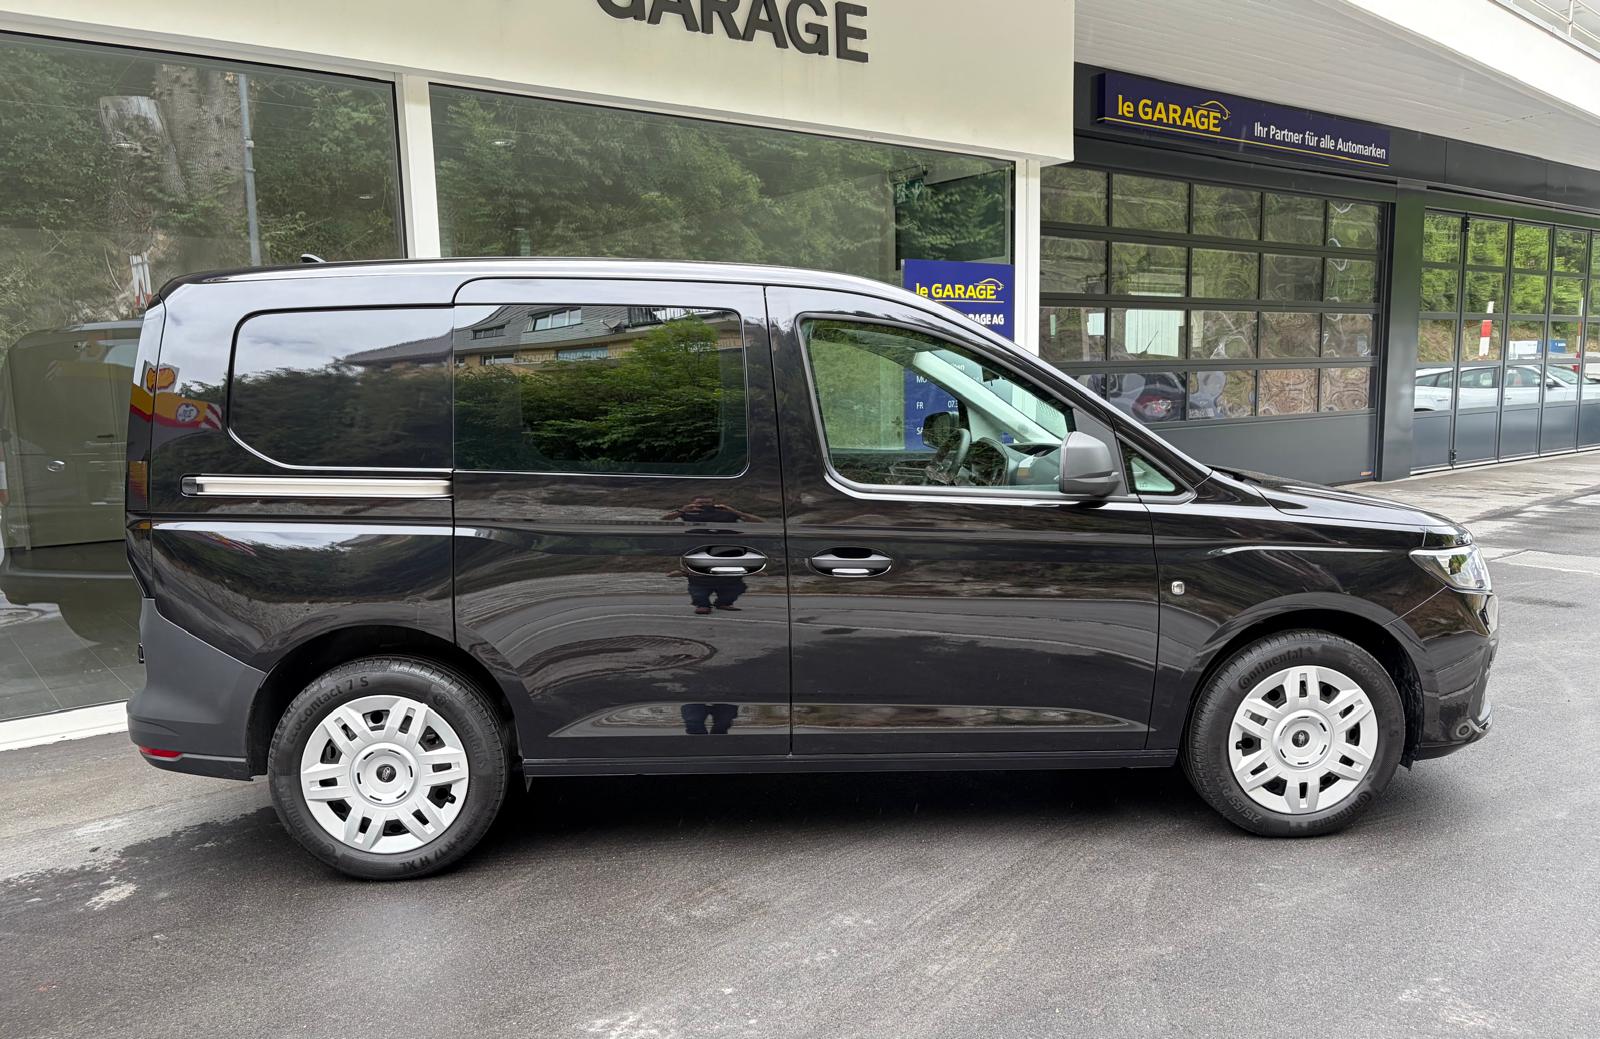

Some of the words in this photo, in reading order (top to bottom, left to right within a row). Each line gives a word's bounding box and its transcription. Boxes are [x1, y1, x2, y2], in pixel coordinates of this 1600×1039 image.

[1118, 95, 1134, 117] le
[1138, 98, 1221, 132] GARAGE
[1254, 121, 1267, 138] Ihr
[1270, 125, 1303, 144] Partner
[1305, 131, 1318, 147] für
[1320, 134, 1335, 150] alle
[1337, 138, 1386, 159] Automarken
[915, 283, 928, 297] le
[931, 283, 997, 299] GARAGE
[992, 313, 1005, 325] AG
[916, 401, 924, 409] FR
[346, 679, 353, 690] 7
[360, 676, 369, 687] S
